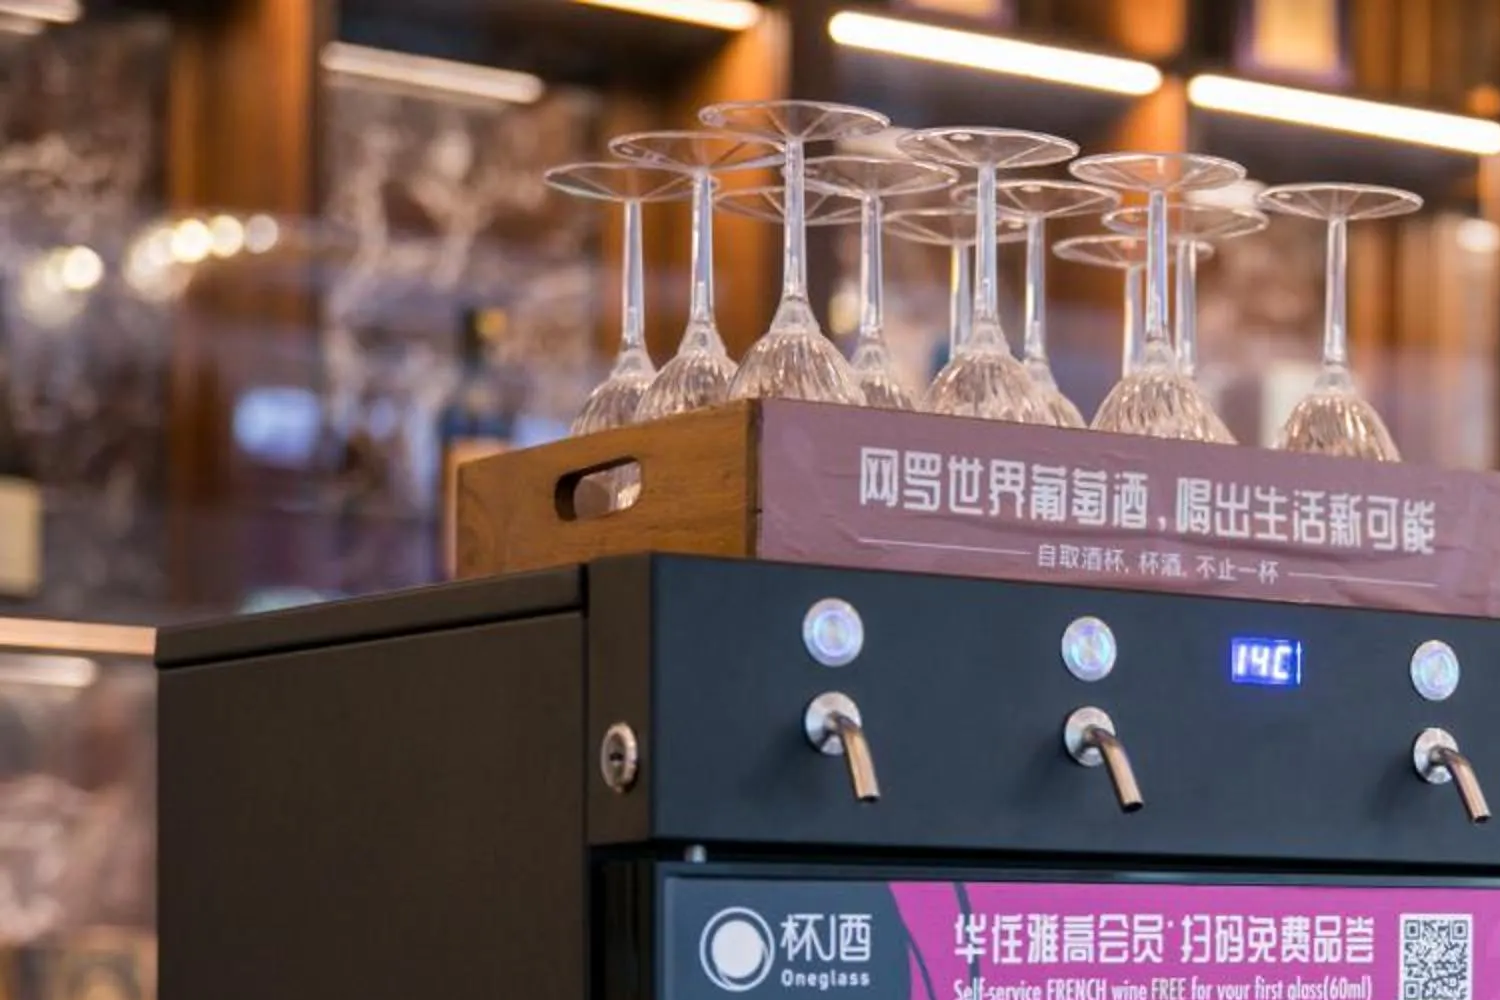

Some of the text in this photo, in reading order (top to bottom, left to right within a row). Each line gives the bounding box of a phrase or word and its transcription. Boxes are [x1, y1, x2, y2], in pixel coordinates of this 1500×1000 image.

[781, 969, 871, 990] Oneglass
[1151, 977, 1186, 1000] FREE
[1191, 975, 1212, 1000] for
[1254, 974, 1283, 1000] first
